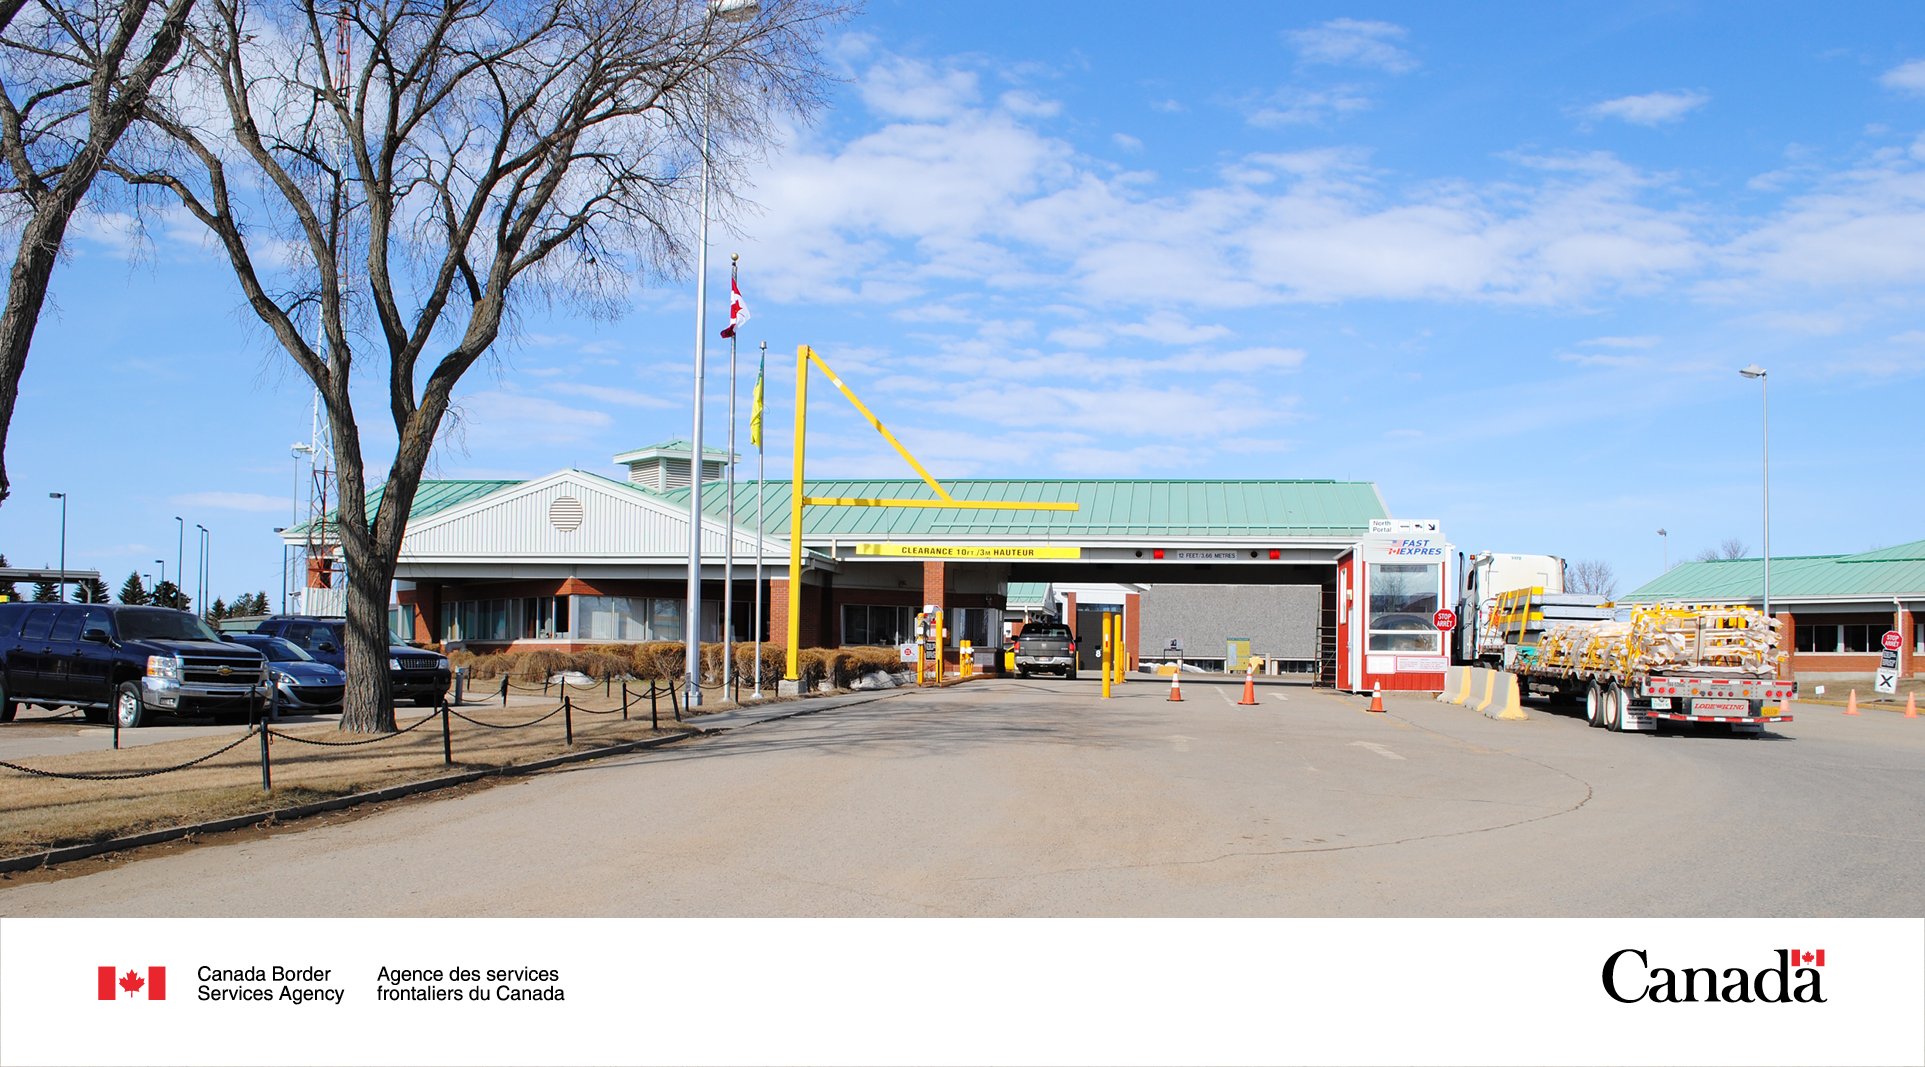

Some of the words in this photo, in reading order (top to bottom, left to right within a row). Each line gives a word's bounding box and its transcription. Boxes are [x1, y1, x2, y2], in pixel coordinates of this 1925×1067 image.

[1402, 539, 1430, 547] FAST
[901, 546, 953, 557] CLEARANCE
[993, 549, 1034, 557] HAUTEUR
[1095, 649, 1102, 658] 8
